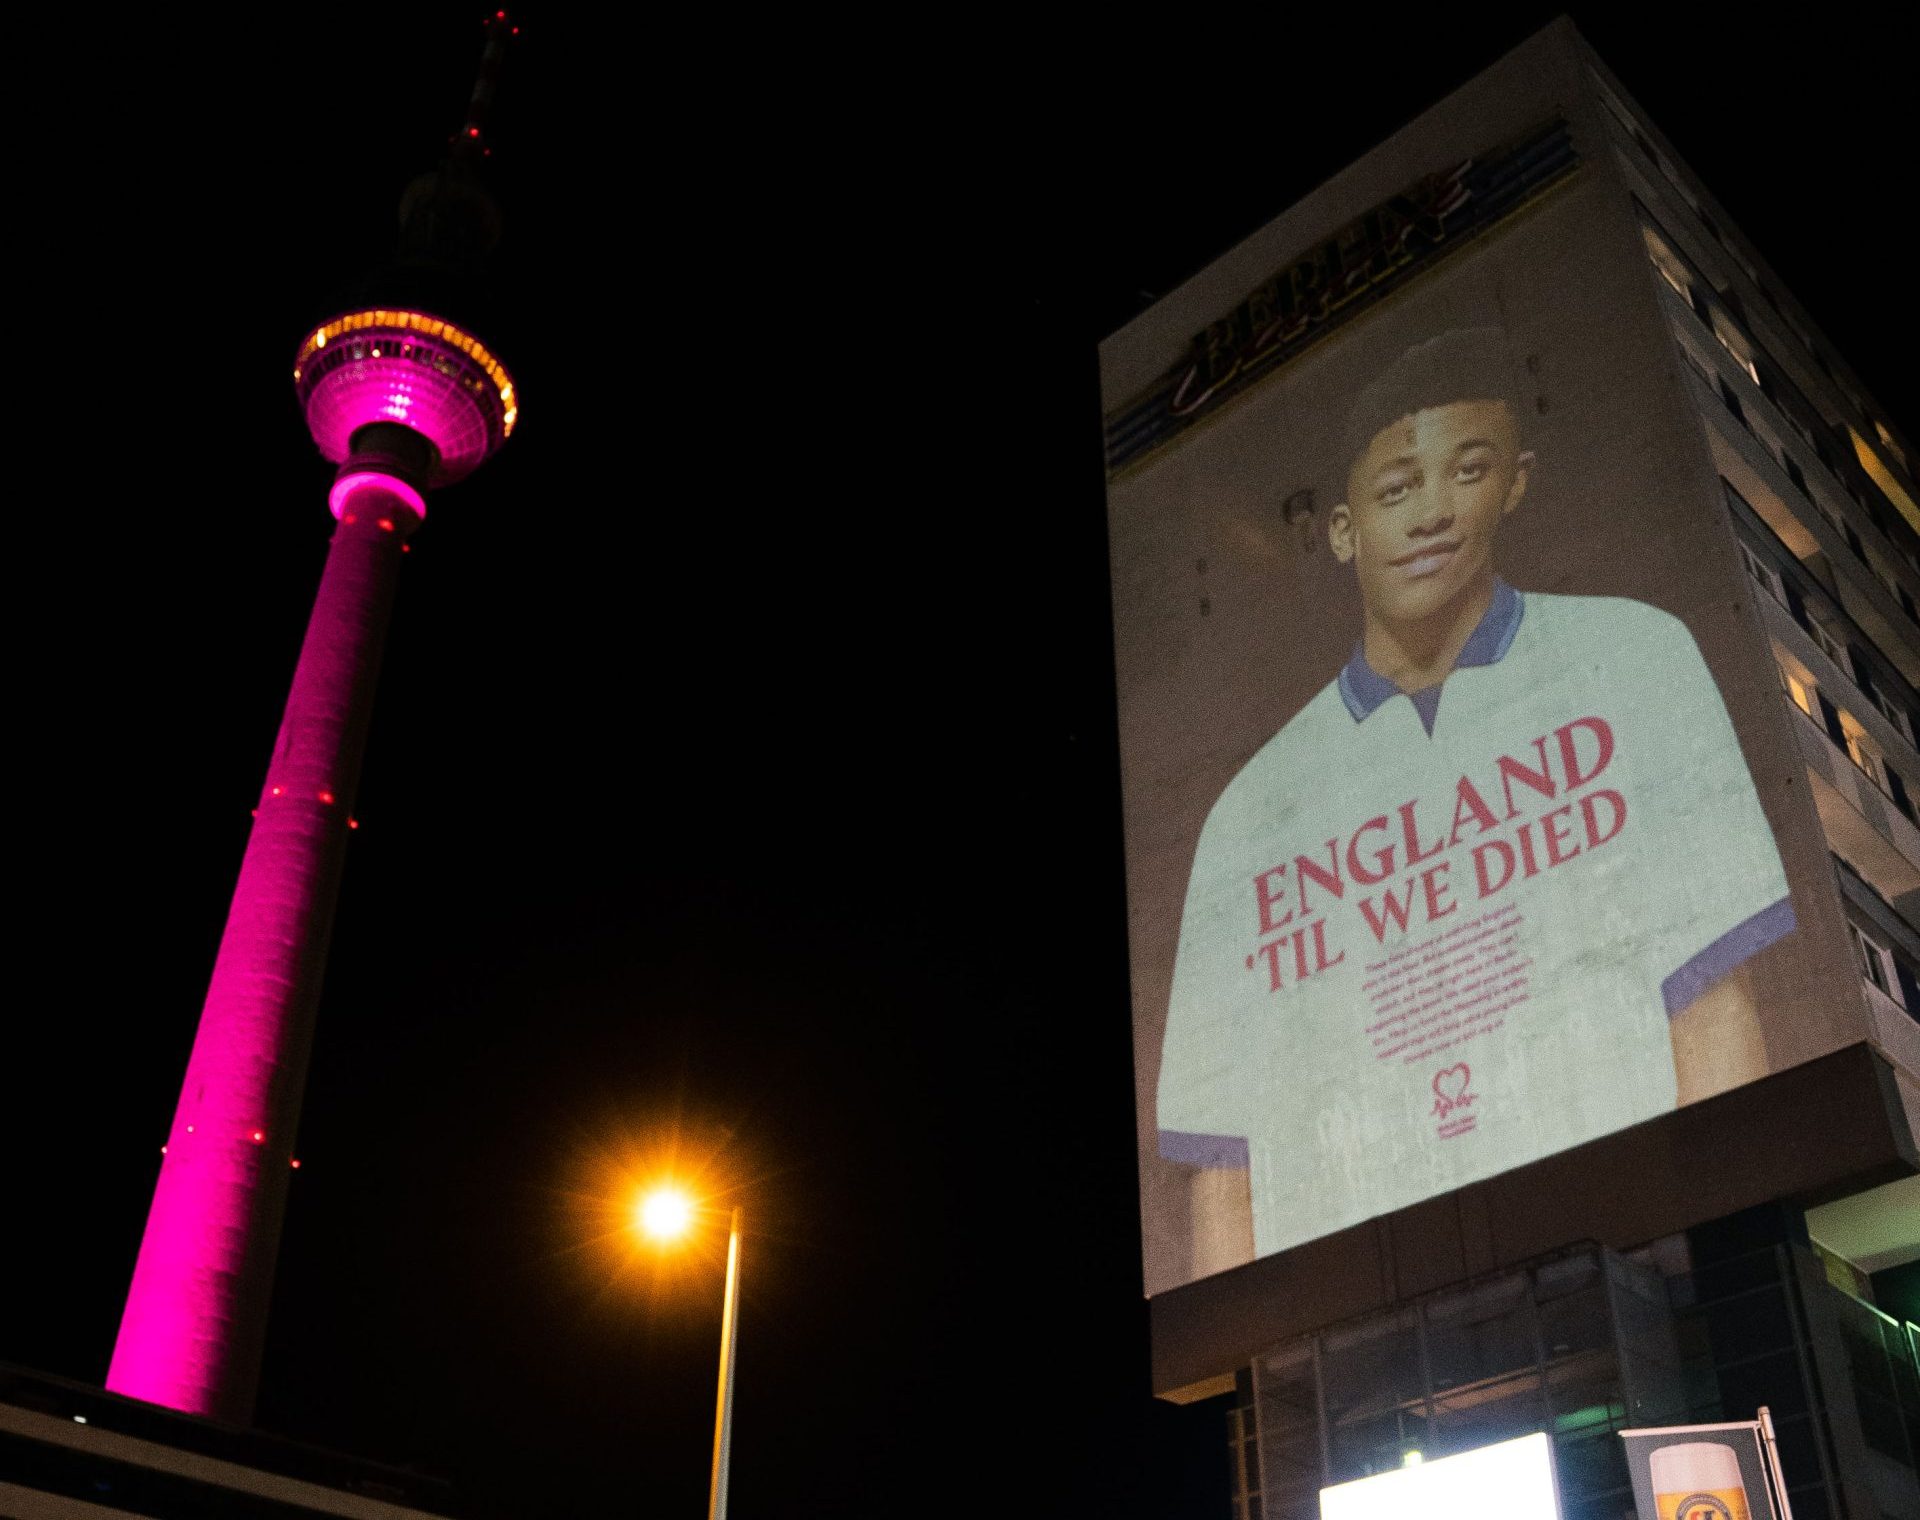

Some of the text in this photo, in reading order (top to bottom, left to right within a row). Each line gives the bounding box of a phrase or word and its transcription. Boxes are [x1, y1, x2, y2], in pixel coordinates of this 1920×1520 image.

[1255, 716, 1616, 935] ENGLAND
[1357, 861, 1458, 944] WE
[1470, 788, 1628, 900] DIED
